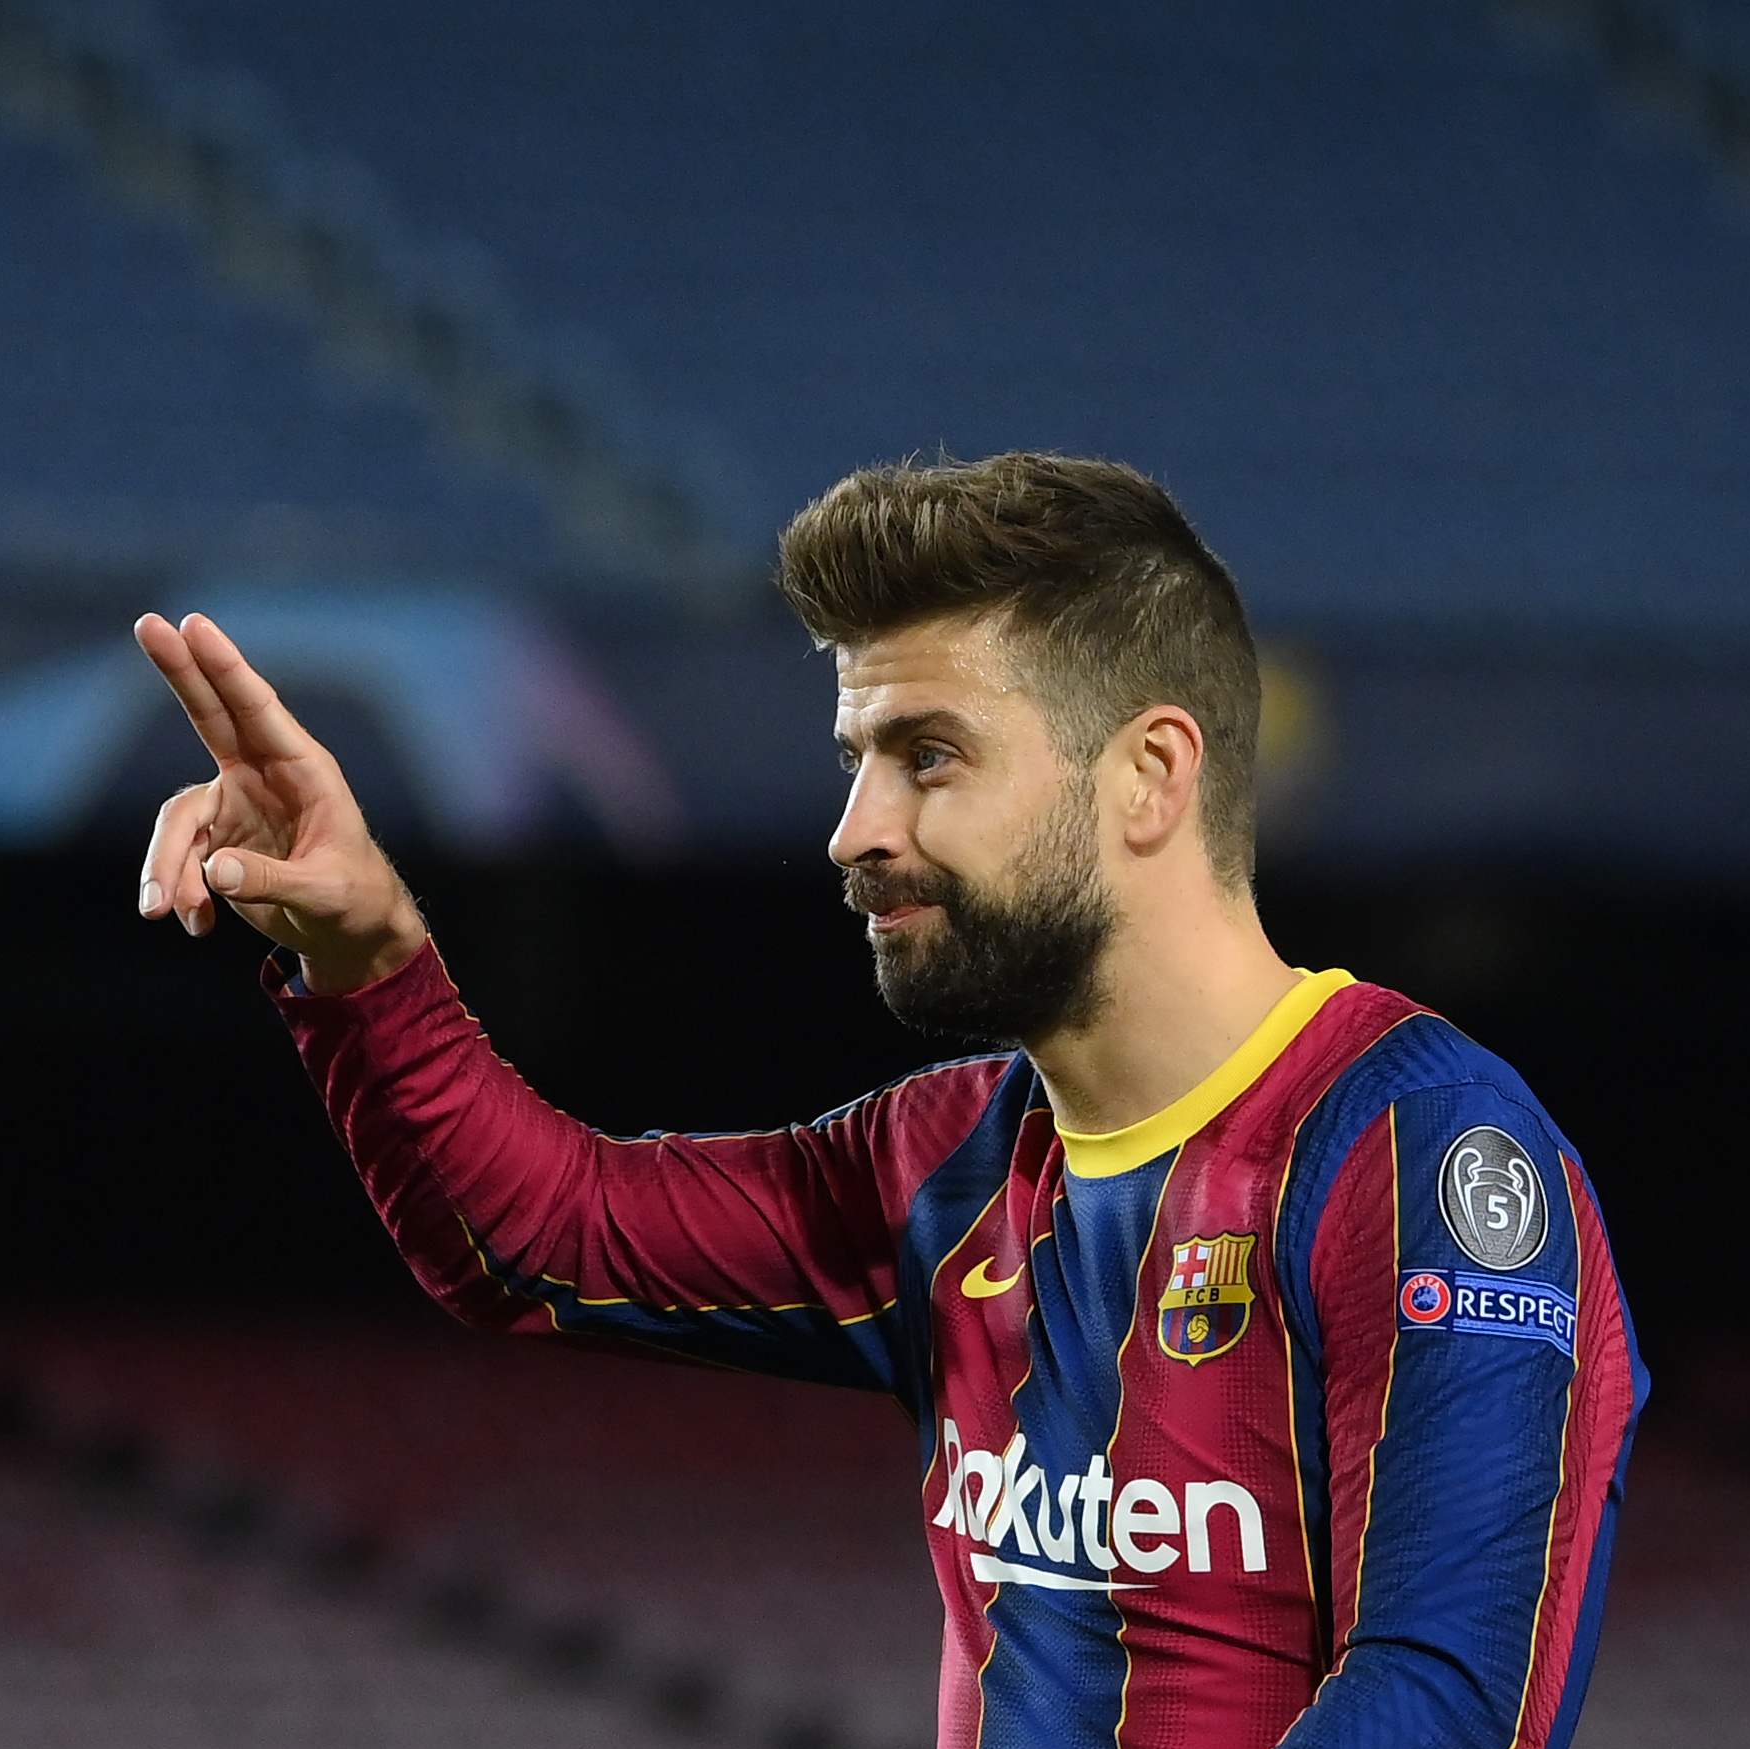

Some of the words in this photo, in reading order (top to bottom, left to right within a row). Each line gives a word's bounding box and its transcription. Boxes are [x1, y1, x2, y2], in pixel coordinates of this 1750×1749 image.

[1486, 1194, 1509, 1230] 5
[1184, 1287, 1220, 1305] FCB
[1457, 1288, 1576, 1339] RESPECT
[932, 1418, 1268, 1573] Rakuten
